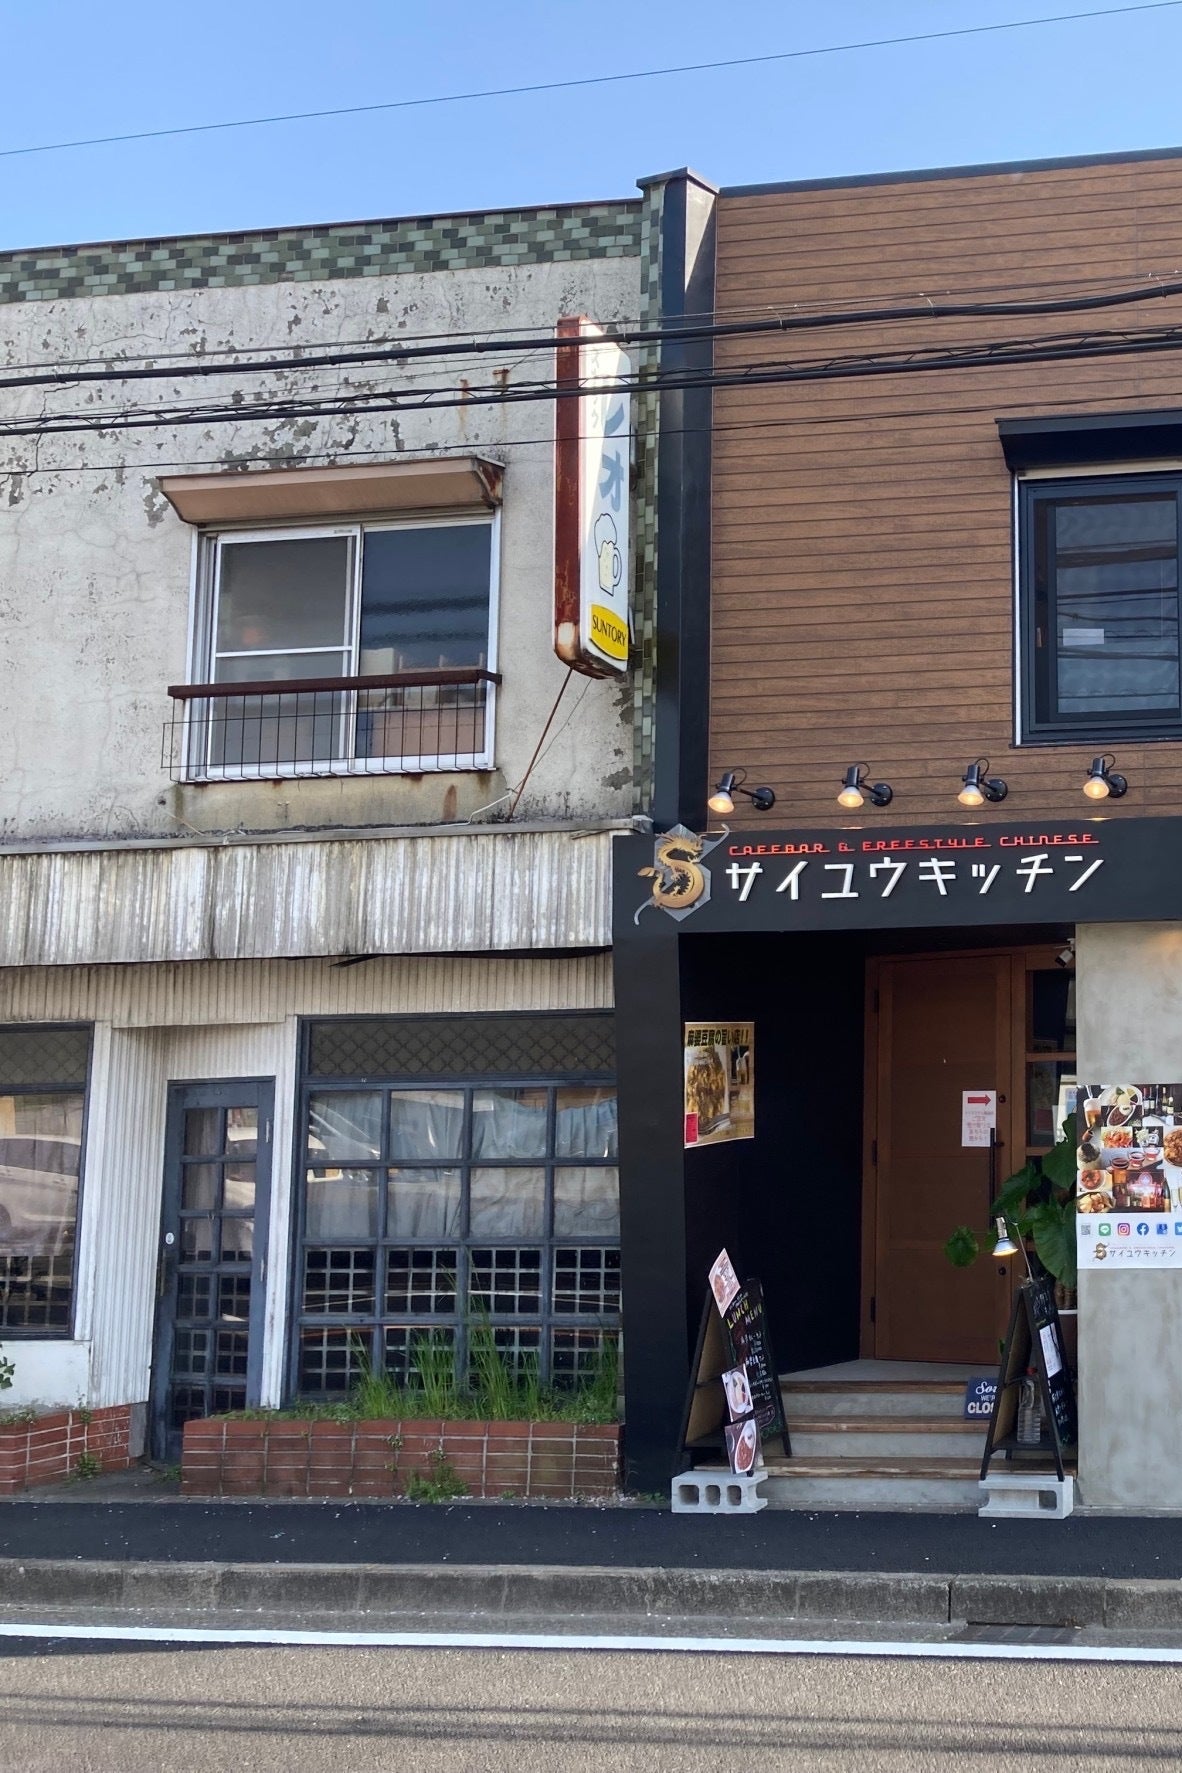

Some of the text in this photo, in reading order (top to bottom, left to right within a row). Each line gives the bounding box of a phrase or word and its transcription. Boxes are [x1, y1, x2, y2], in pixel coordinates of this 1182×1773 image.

[592, 615, 626, 647] SUNTORY
[999, 833, 1099, 848] CHINESE
[725, 852, 1104, 903] サイユウキッチン
[1109, 1249, 1176, 1258] サイユウキッチン
